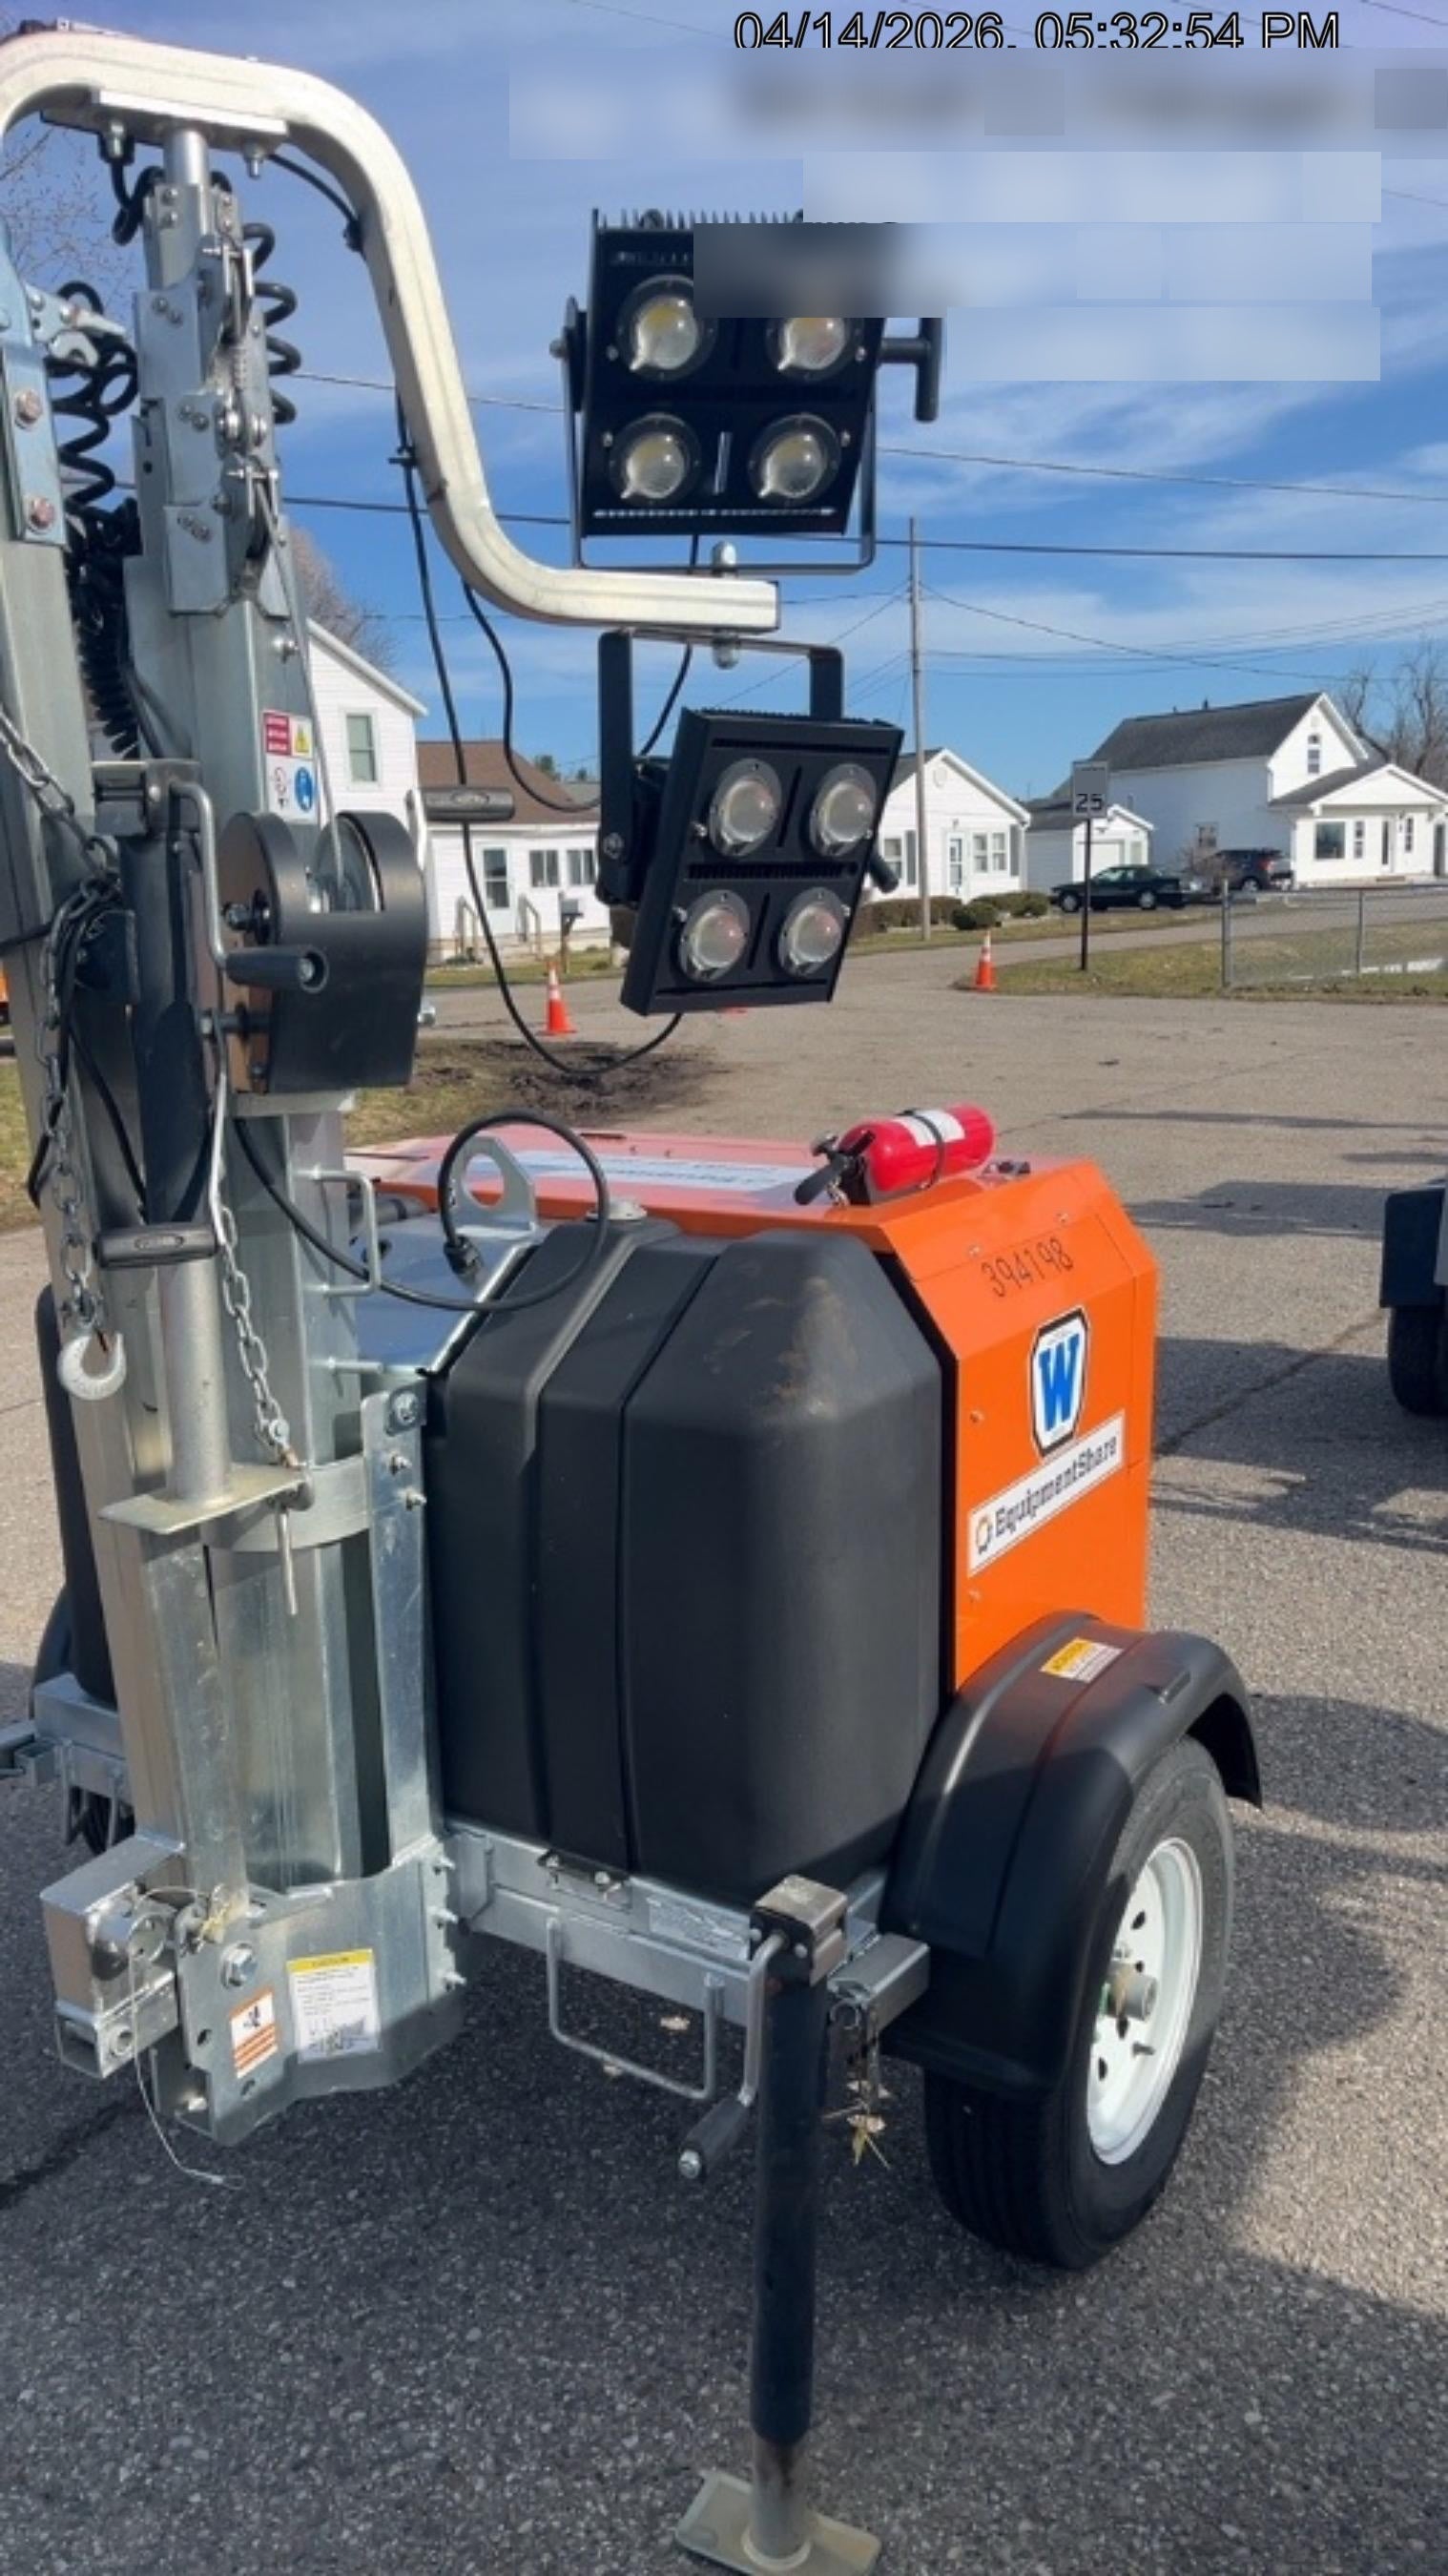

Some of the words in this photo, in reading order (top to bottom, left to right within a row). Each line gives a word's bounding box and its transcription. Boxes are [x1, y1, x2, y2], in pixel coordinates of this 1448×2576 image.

[1075, 793, 1103, 813] 25
[981, 1236, 1074, 1298] 394198
[1039, 1333, 1080, 1432] W
[995, 1436, 1116, 1538] EquipmentShare
